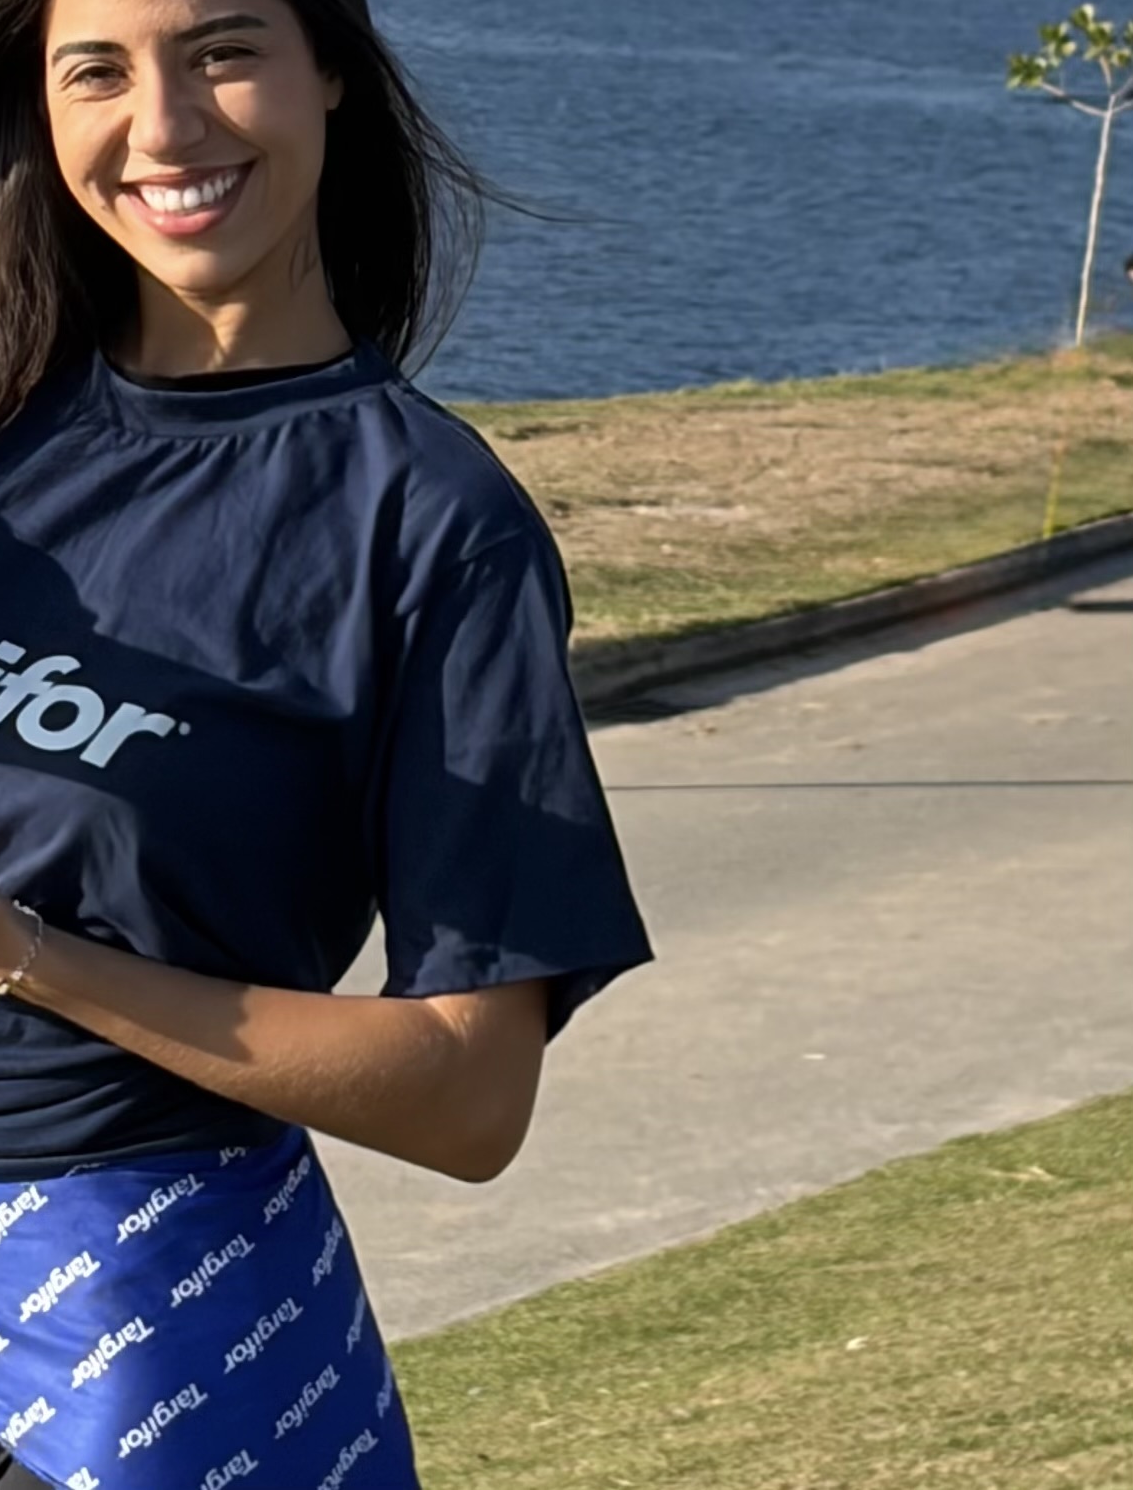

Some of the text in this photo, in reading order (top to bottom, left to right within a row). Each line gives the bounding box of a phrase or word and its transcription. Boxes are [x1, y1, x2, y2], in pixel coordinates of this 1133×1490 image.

[116, 1173, 205, 1245] Targifor
[19, 1250, 102, 1324] Targifor
[170, 1233, 256, 1308] Targifor
[71, 1315, 156, 1389] Targifor
[223, 1297, 304, 1375] Targifor
[118, 1382, 209, 1459] Targifor
[274, 1364, 341, 1439] Targifor
